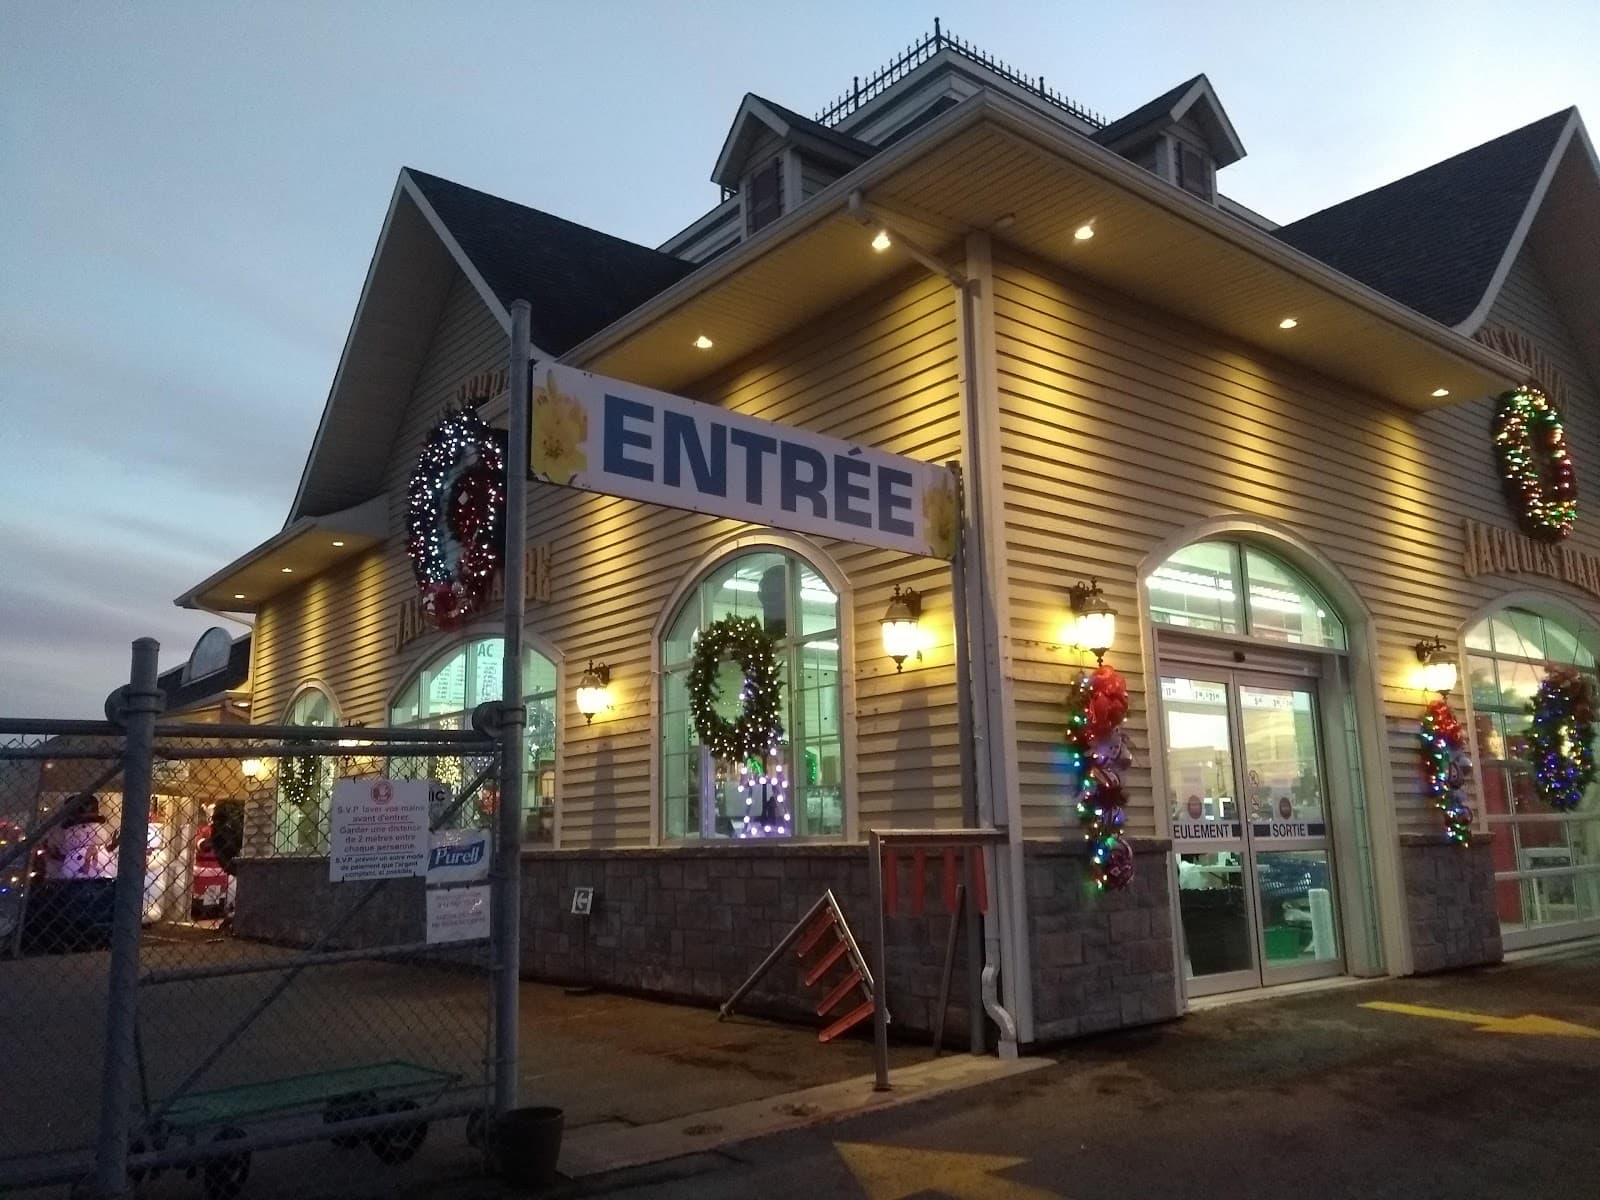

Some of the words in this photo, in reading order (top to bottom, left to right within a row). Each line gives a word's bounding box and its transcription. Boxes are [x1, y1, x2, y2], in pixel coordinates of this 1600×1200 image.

[604, 394, 914, 537] ENTRÉE
[362, 805, 382, 813] laver
[340, 826, 368, 834] Garder
[1272, 823, 1306, 838] SORTIE
[345, 836, 356, 844] de
[358, 835, 364, 843] 2
[344, 845, 375, 854] chaque
[435, 846, 480, 865] Purell
